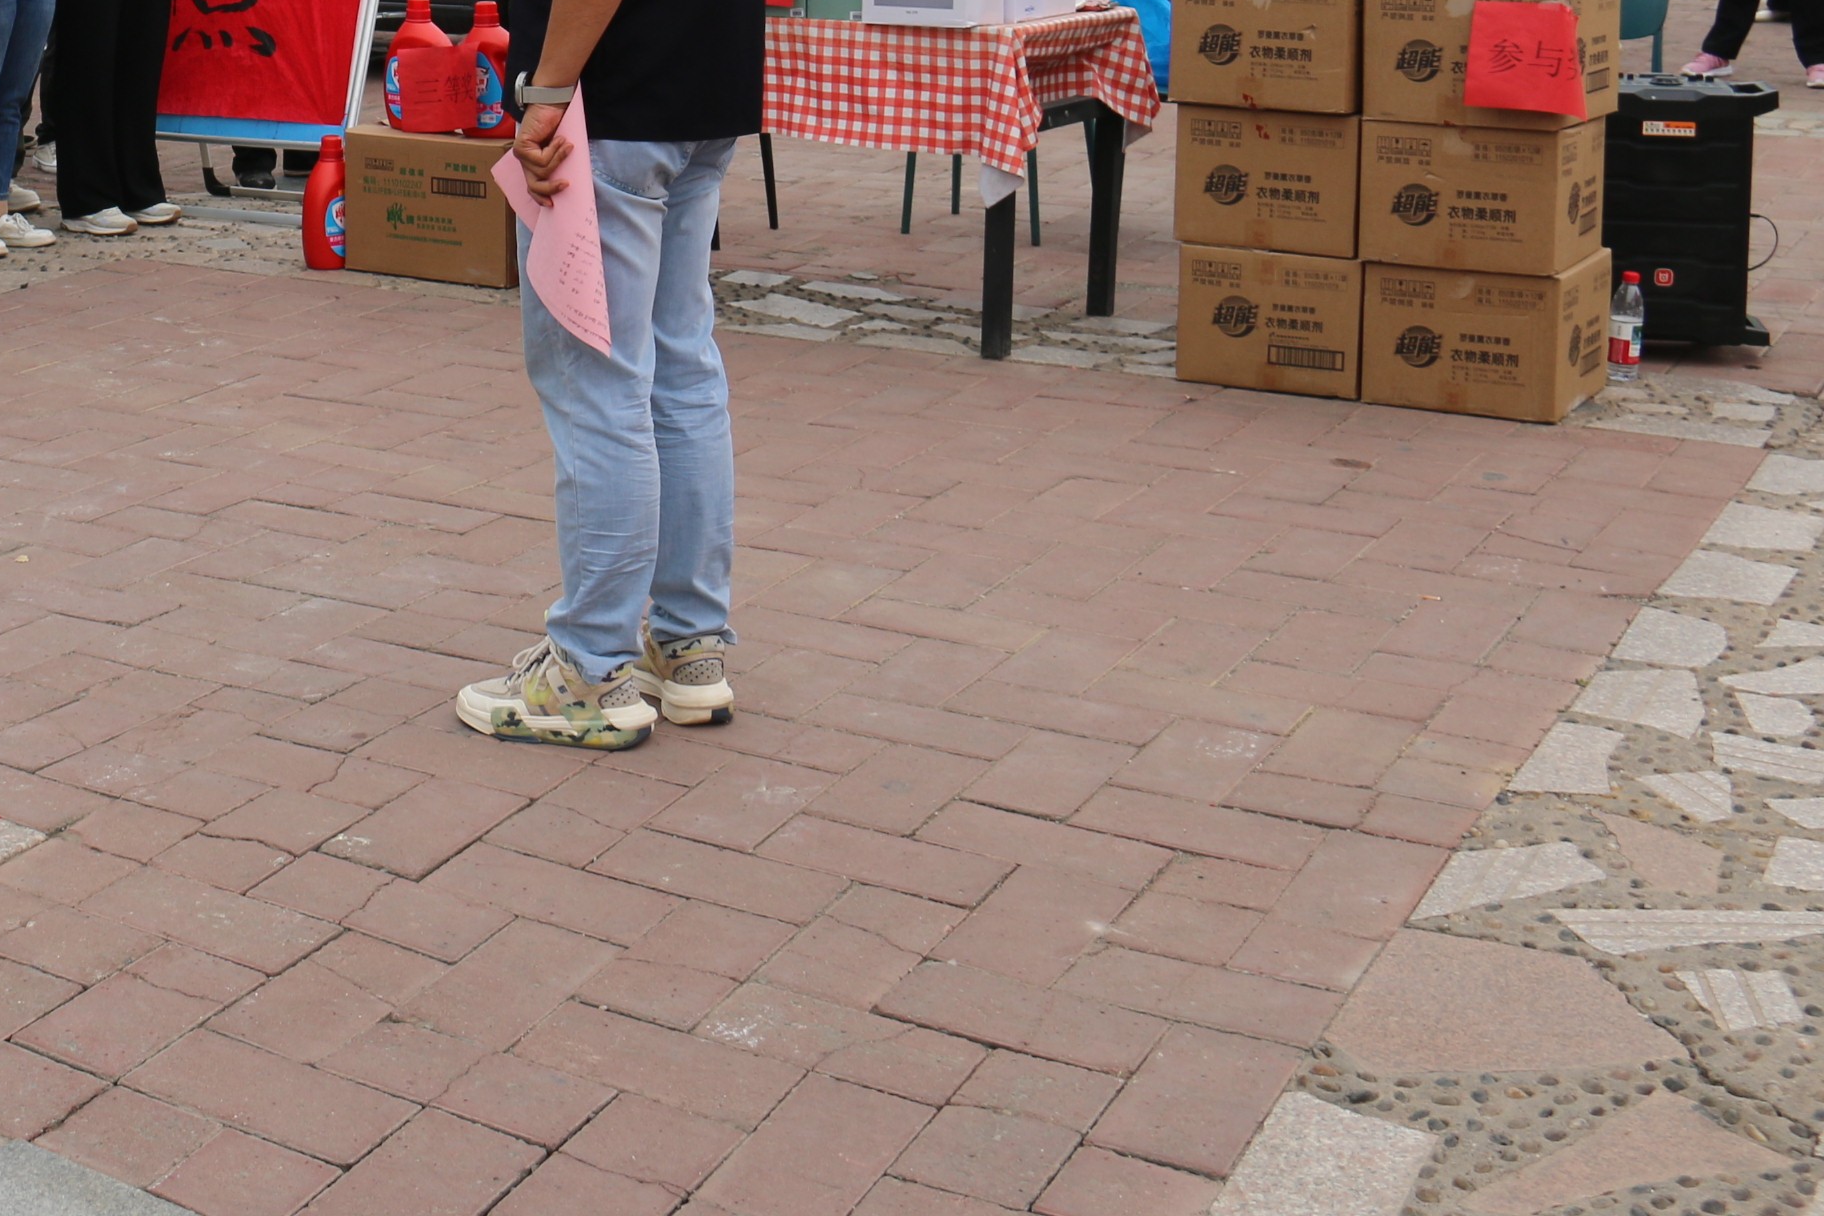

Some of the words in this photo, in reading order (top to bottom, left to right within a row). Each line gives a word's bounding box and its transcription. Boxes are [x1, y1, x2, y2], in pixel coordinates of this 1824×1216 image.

[1198, 30, 1243, 56] 超能
[1249, 45, 1312, 63] 衣物柔顺剂
[1395, 45, 1443, 72] 超能
[414, 72, 475, 104] 三等奖
[1203, 172, 1249, 195] 超能
[1256, 186, 1320, 204] 衣物柔顺剂
[1391, 191, 1440, 217] 超能
[1447, 205, 1517, 224] 衣物柔顺剂
[1212, 303, 1260, 328] 超能
[1265, 316, 1323, 334] 衣物柔顺剂
[1394, 333, 1443, 358] 超能
[1450, 348, 1519, 368] 衣物柔顺剂
